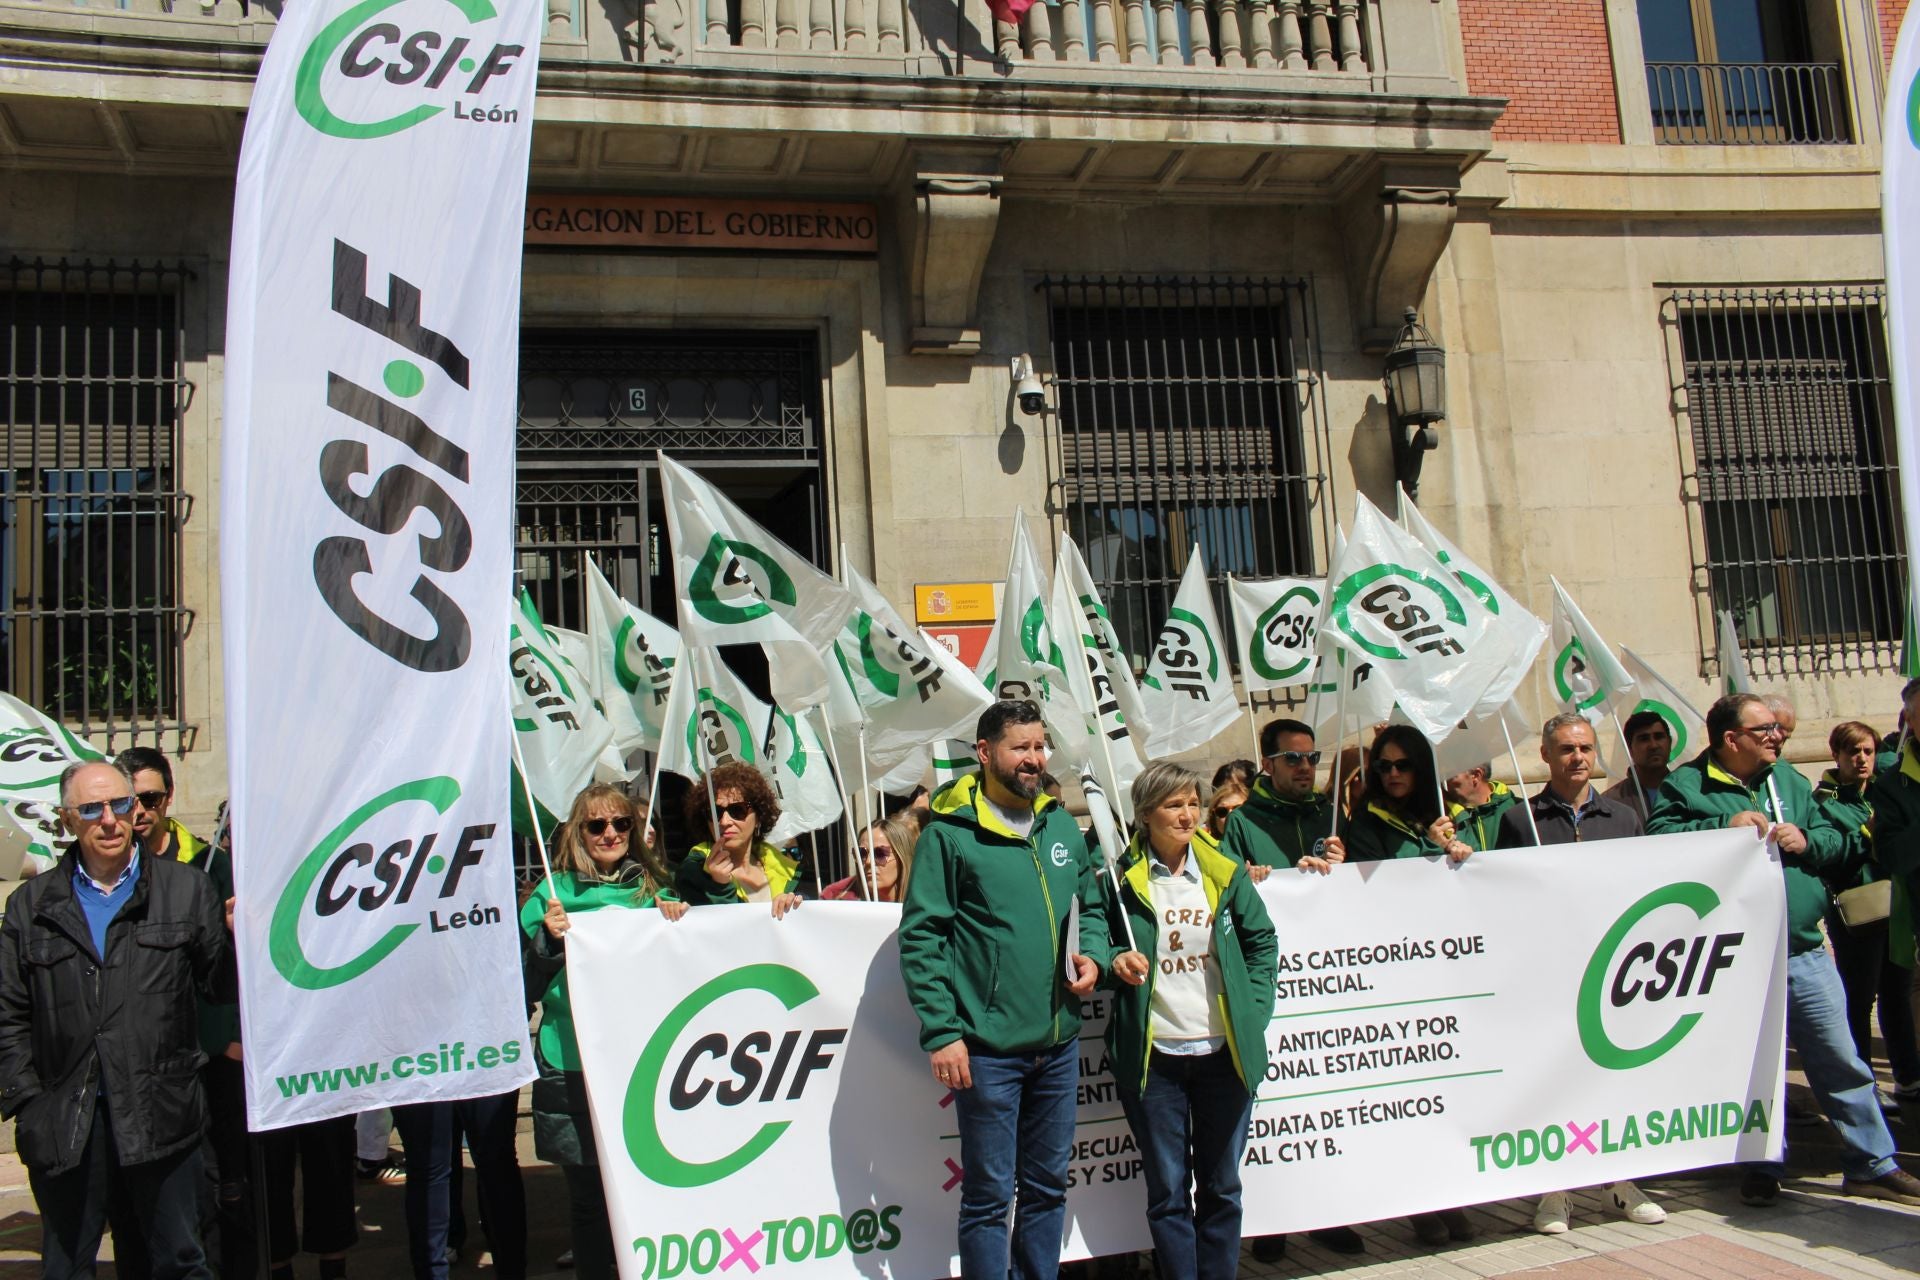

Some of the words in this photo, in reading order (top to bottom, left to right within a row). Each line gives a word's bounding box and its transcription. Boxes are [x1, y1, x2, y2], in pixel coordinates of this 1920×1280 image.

[454, 101, 519, 123] León
[525, 207, 644, 234] GACION
[654, 210, 715, 236] DEL
[725, 211, 874, 240] GOBIERNO
[631, 391, 644, 409] 6
[1361, 584, 1465, 656] CSIF
[1158, 626, 1210, 702] CSIF
[429, 903, 501, 933] León
[1169, 930, 1184, 952] &
[1307, 937, 1436, 971] CATEGORÍAS
[1441, 936, 1485, 959] QUE
[1611, 932, 1745, 1007] CSIF
[1278, 1023, 1394, 1054] ANTICIPADA
[1396, 1021, 1410, 1040] Y
[1416, 1015, 1460, 1037] POR
[275, 1040, 521, 1098] www.csif.es
[669, 1028, 848, 1111] CSIF
[1324, 1042, 1460, 1074] ESTATUTARIO.
[1321, 1109, 1344, 1130] DE
[1349, 1095, 1445, 1126] TÉCNICOS
[1646, 1099, 1773, 1146] SANIDA
[1081, 1166, 1096, 1185] Y
[1244, 1145, 1273, 1166] AL
[1324, 1137, 1343, 1157] B.
